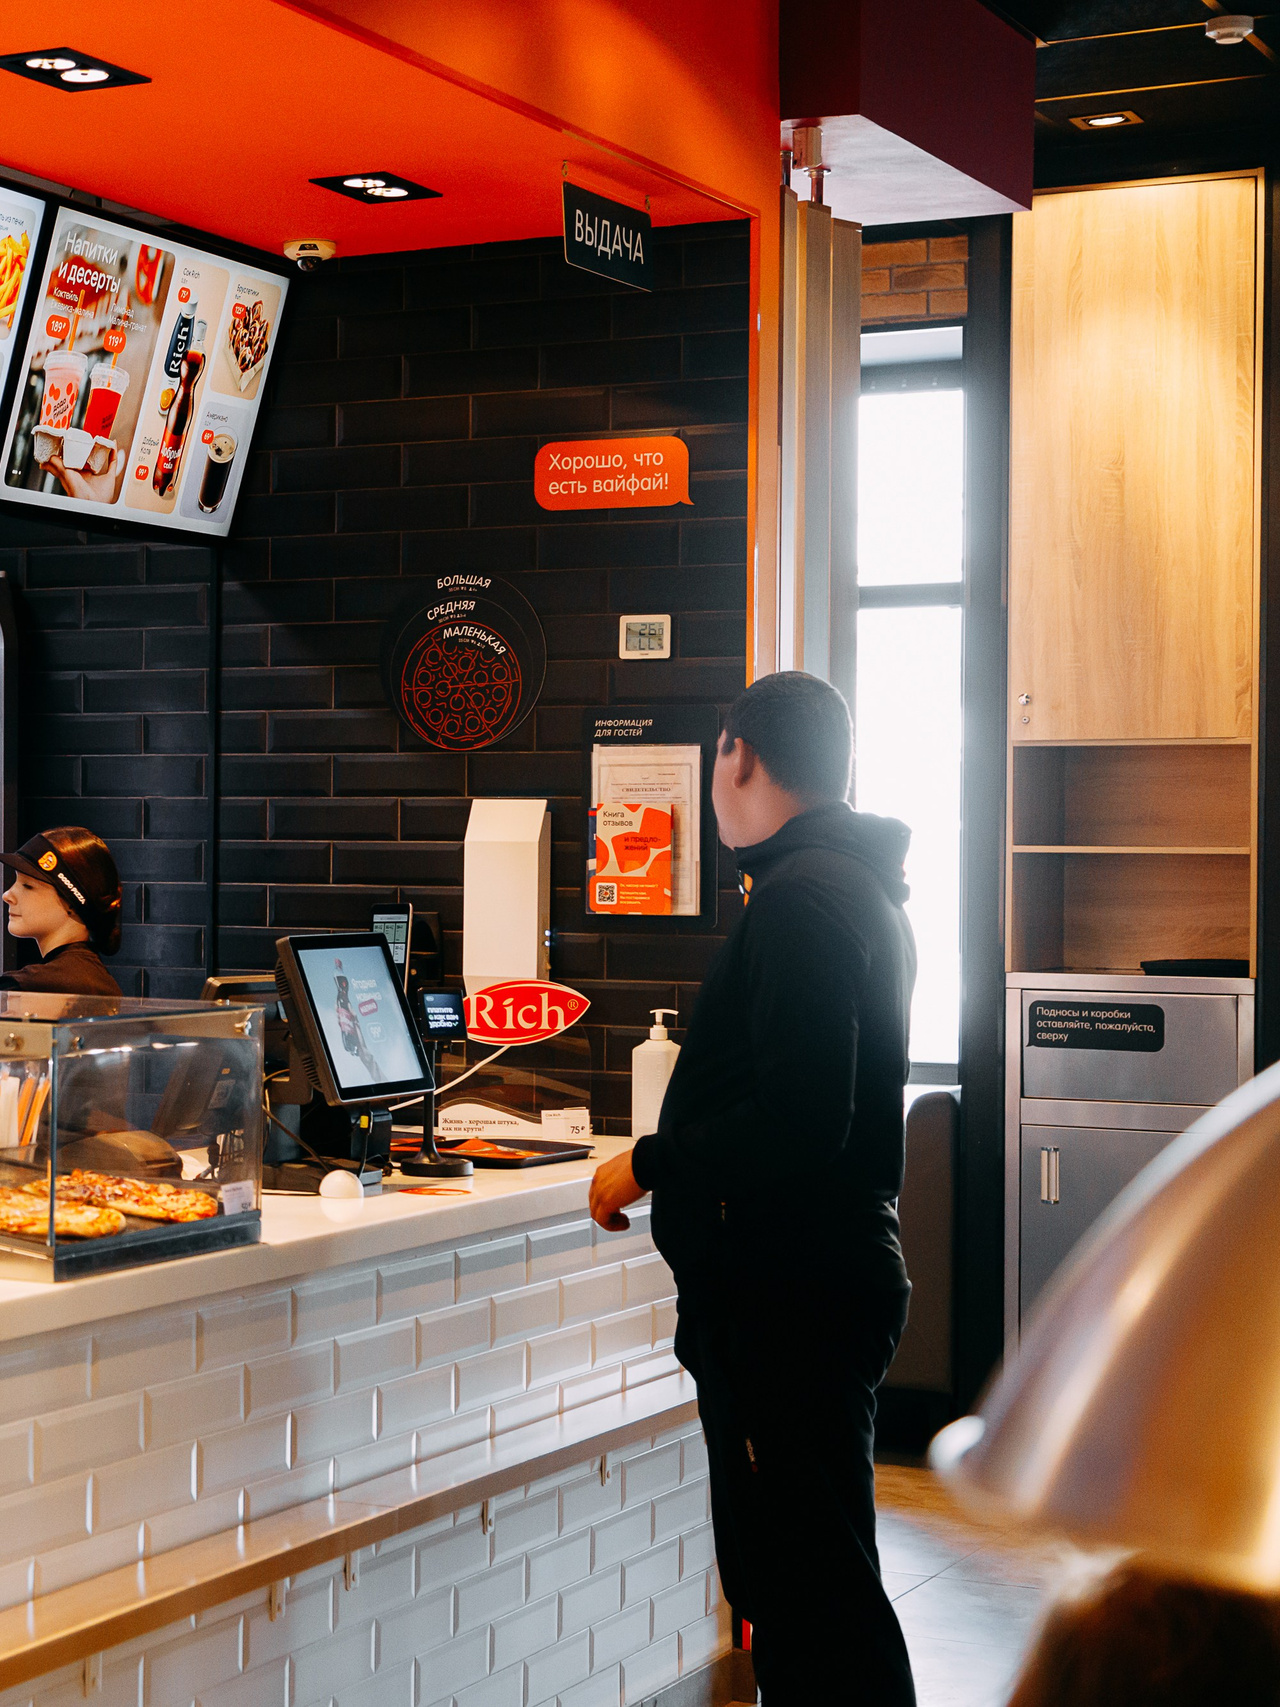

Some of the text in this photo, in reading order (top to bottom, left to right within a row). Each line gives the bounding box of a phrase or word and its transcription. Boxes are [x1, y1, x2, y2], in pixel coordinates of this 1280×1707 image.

[574, 208, 644, 265] ВЫДАЧА
[64, 231, 118, 266] Напитки
[58, 261, 121, 293] и десерты
[169, 326, 189, 373] Rich
[549, 452, 664, 474] Хорошо, что
[548, 473, 669, 496] есть вайфай!
[437, 574, 492, 589] БОЛЬШАЯ
[427, 600, 476, 620] СРЕДНЯЯ
[443, 626, 506, 655] МАЛЕНЬКАЯ
[594, 728, 643, 737] ДЛЯ ГОСТЕЙ
[595, 719, 653, 727] ИНФОРМАЦИЯ
[57, 873, 86, 904] DODO PIZZA
[467, 992, 567, 1030] Rich
[1036, 1006, 1079, 1018] Подносы
[1091, 1008, 1131, 1021] коробки
[1036, 1019, 1156, 1034] оставляйте, пожалуйста,
[1036, 1031, 1069, 1042] сверху
